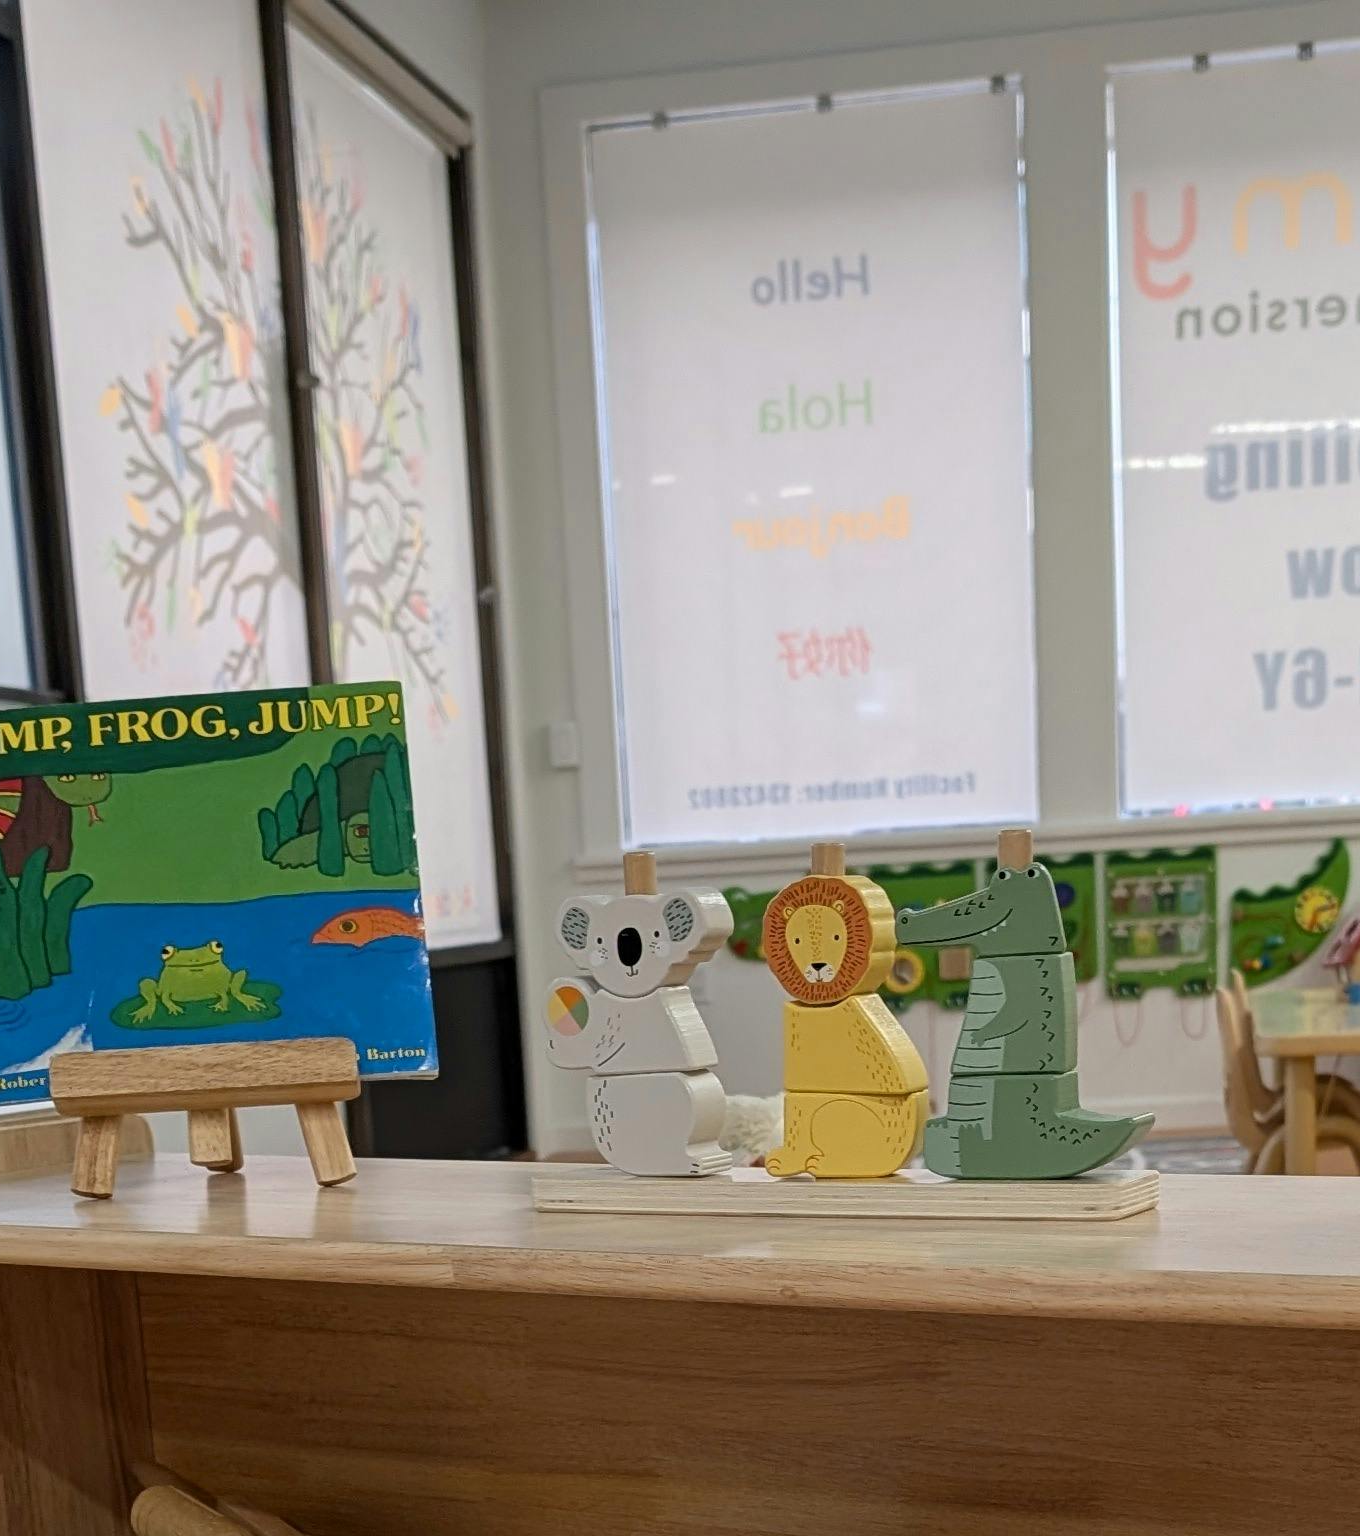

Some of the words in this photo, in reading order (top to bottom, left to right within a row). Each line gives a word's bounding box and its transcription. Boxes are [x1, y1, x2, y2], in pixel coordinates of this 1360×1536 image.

[88, 705, 240, 747] FROG,
[248, 693, 403, 736] JUMP!
[366, 1045, 427, 1061] Barton
